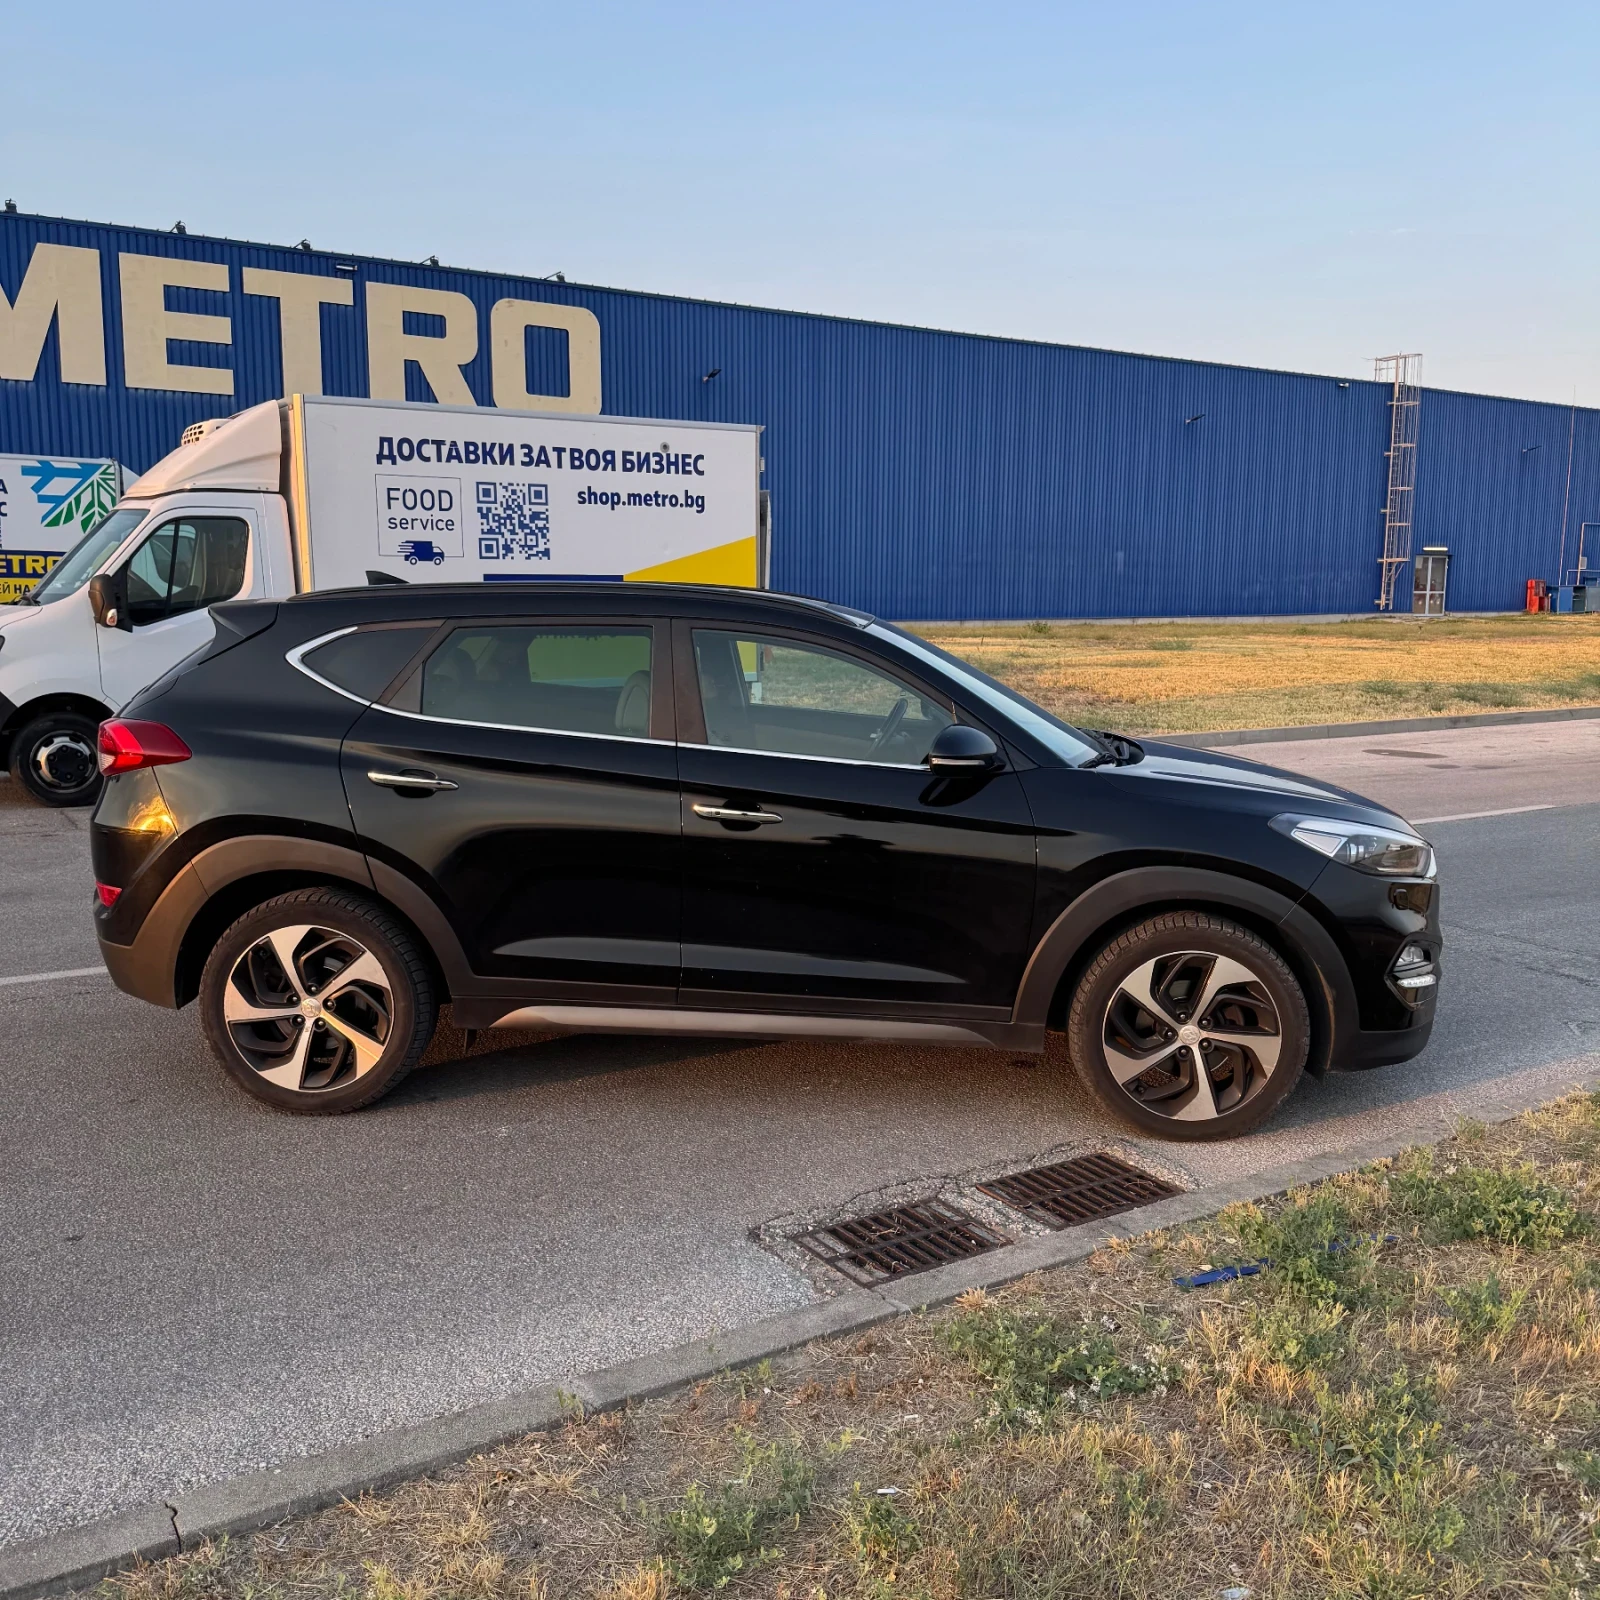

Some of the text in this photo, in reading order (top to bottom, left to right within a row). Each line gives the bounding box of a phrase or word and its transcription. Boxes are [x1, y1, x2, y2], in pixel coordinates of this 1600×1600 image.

[0, 243, 602, 415] METRO
[376, 436, 515, 466] ДОСТАВКИ
[621, 451, 705, 476] БИЗНЕС
[386, 487, 453, 512] FOOD
[577, 486, 705, 514] shop.metro.bg
[387, 514, 455, 532] service
